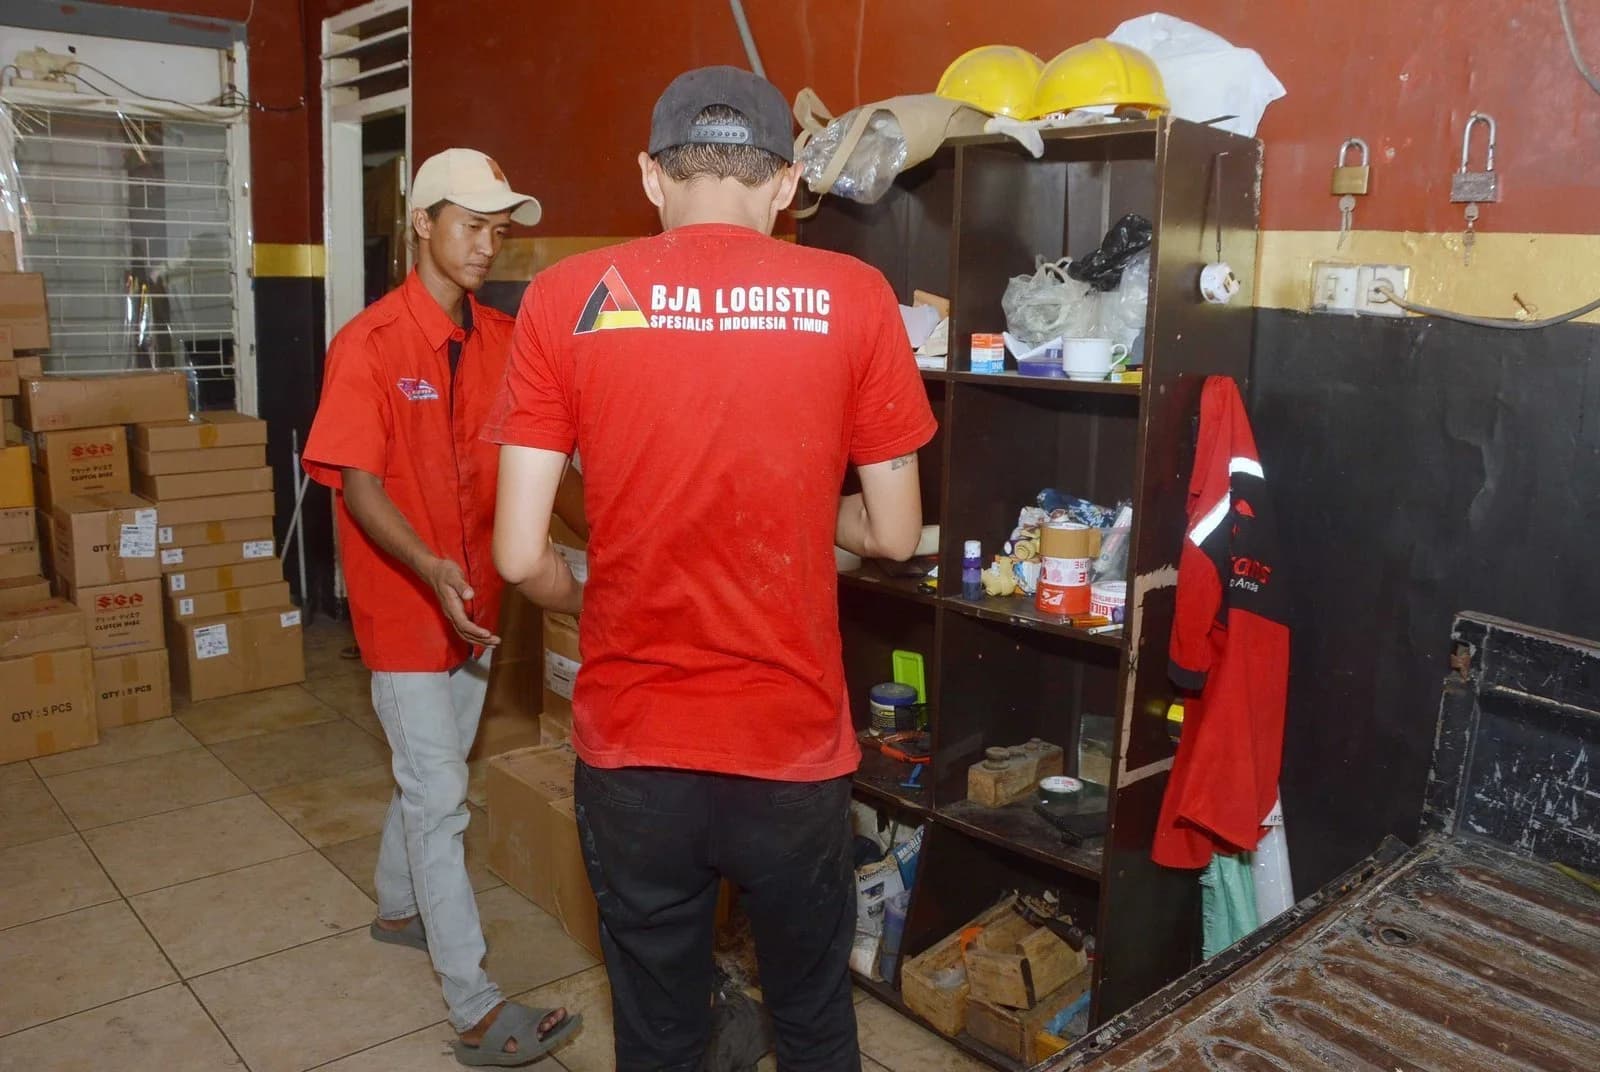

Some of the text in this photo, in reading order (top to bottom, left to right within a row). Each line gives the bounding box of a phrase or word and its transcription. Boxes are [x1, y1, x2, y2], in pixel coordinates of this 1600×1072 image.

[651, 284, 831, 316] BJA LOGISTIC
[650, 314, 829, 334] SPESIALIS INDONESIA TIMUR
[92, 544, 111, 553] QTY
[101, 690, 120, 700] QTY
[134, 684, 152, 694] PCS
[11, 710, 34, 723] QTY
[43, 706, 49, 717] 5
[51, 702, 73, 715] PCS
